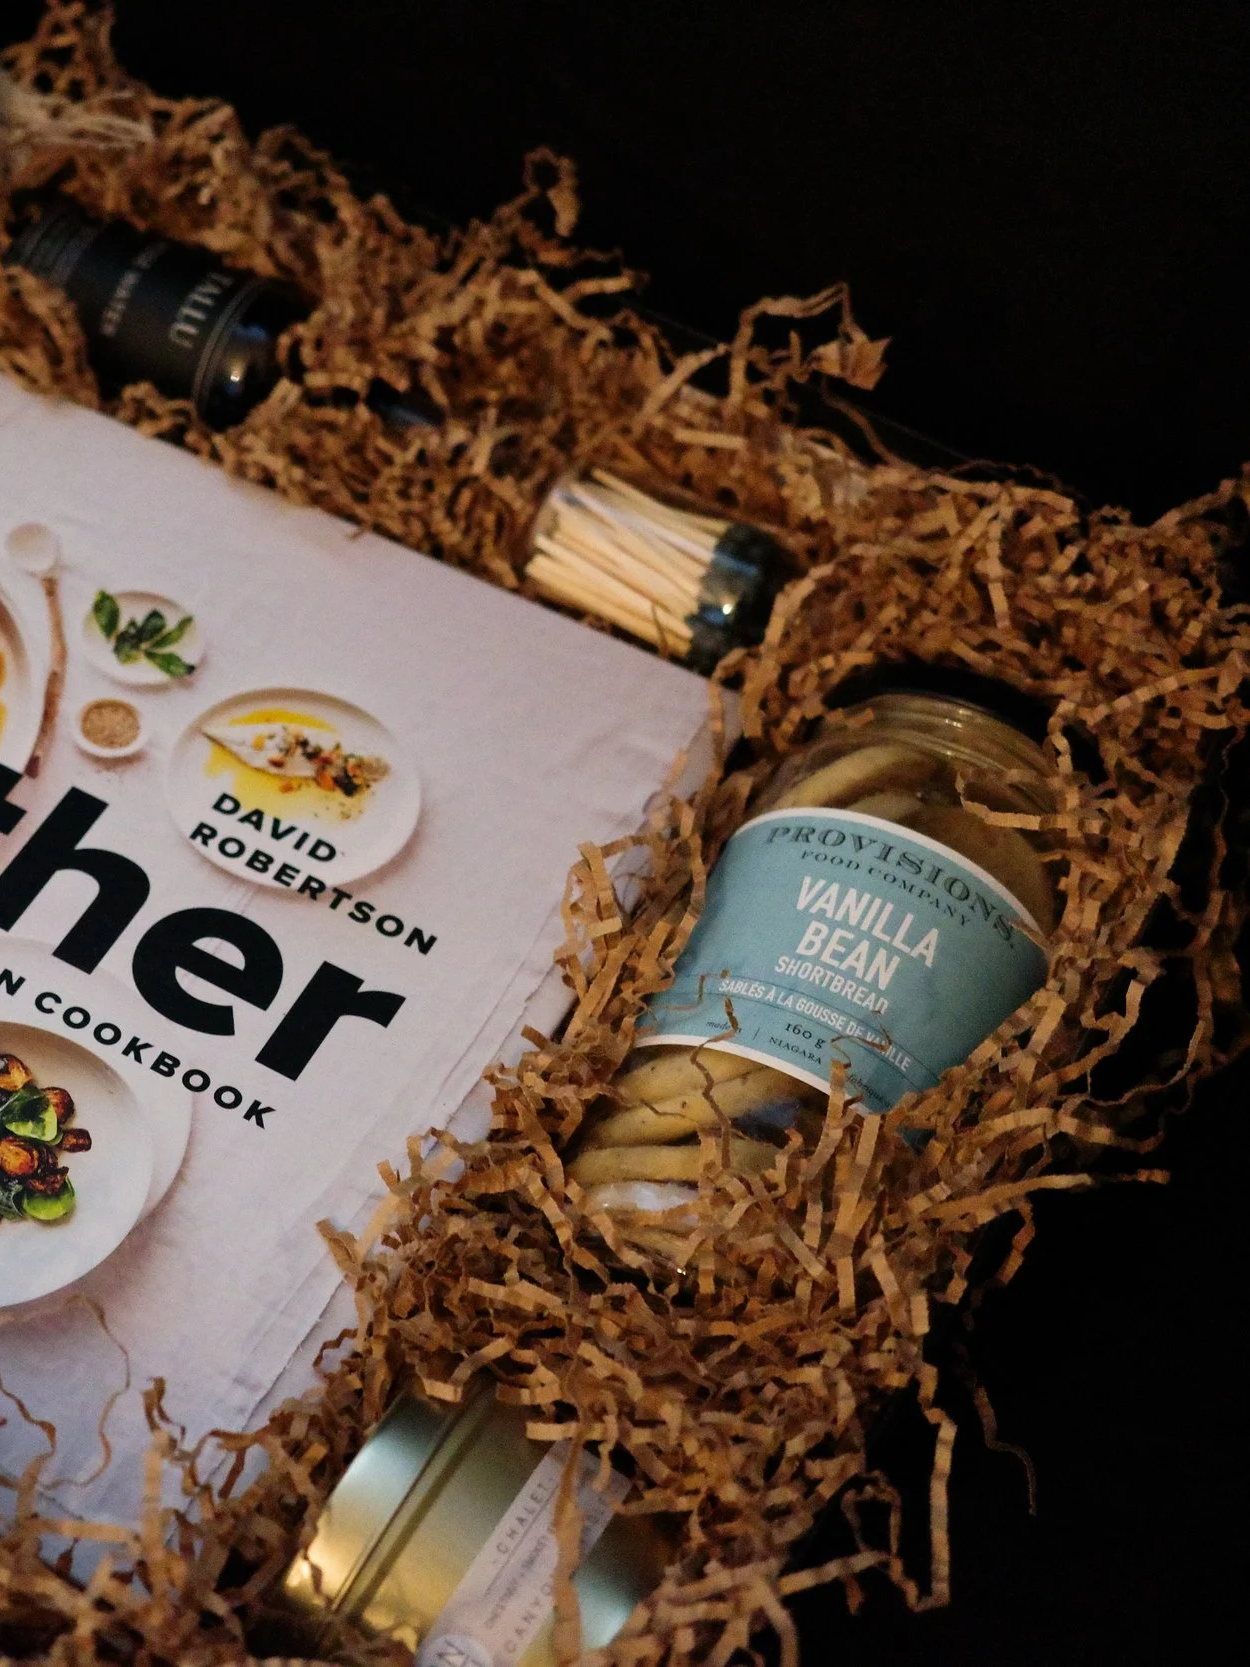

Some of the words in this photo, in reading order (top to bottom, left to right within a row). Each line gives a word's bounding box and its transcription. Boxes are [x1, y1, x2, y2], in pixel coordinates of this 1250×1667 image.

[212, 792, 338, 864] DAVID
[189, 821, 439, 956] ROBERTSON
[765, 824, 1015, 942] PROVISIONS
[794, 876, 940, 969] VANILLA
[801, 848, 860, 871] FOOD
[867, 867, 971, 927] COMPANY
[795, 922, 901, 991] BEAN
[777, 993, 795, 1009] LA
[795, 998, 846, 1029] GOUSSE
[34, 992, 277, 1130] COOKBOOK
[768, 1036, 823, 1066] NIAGARA
